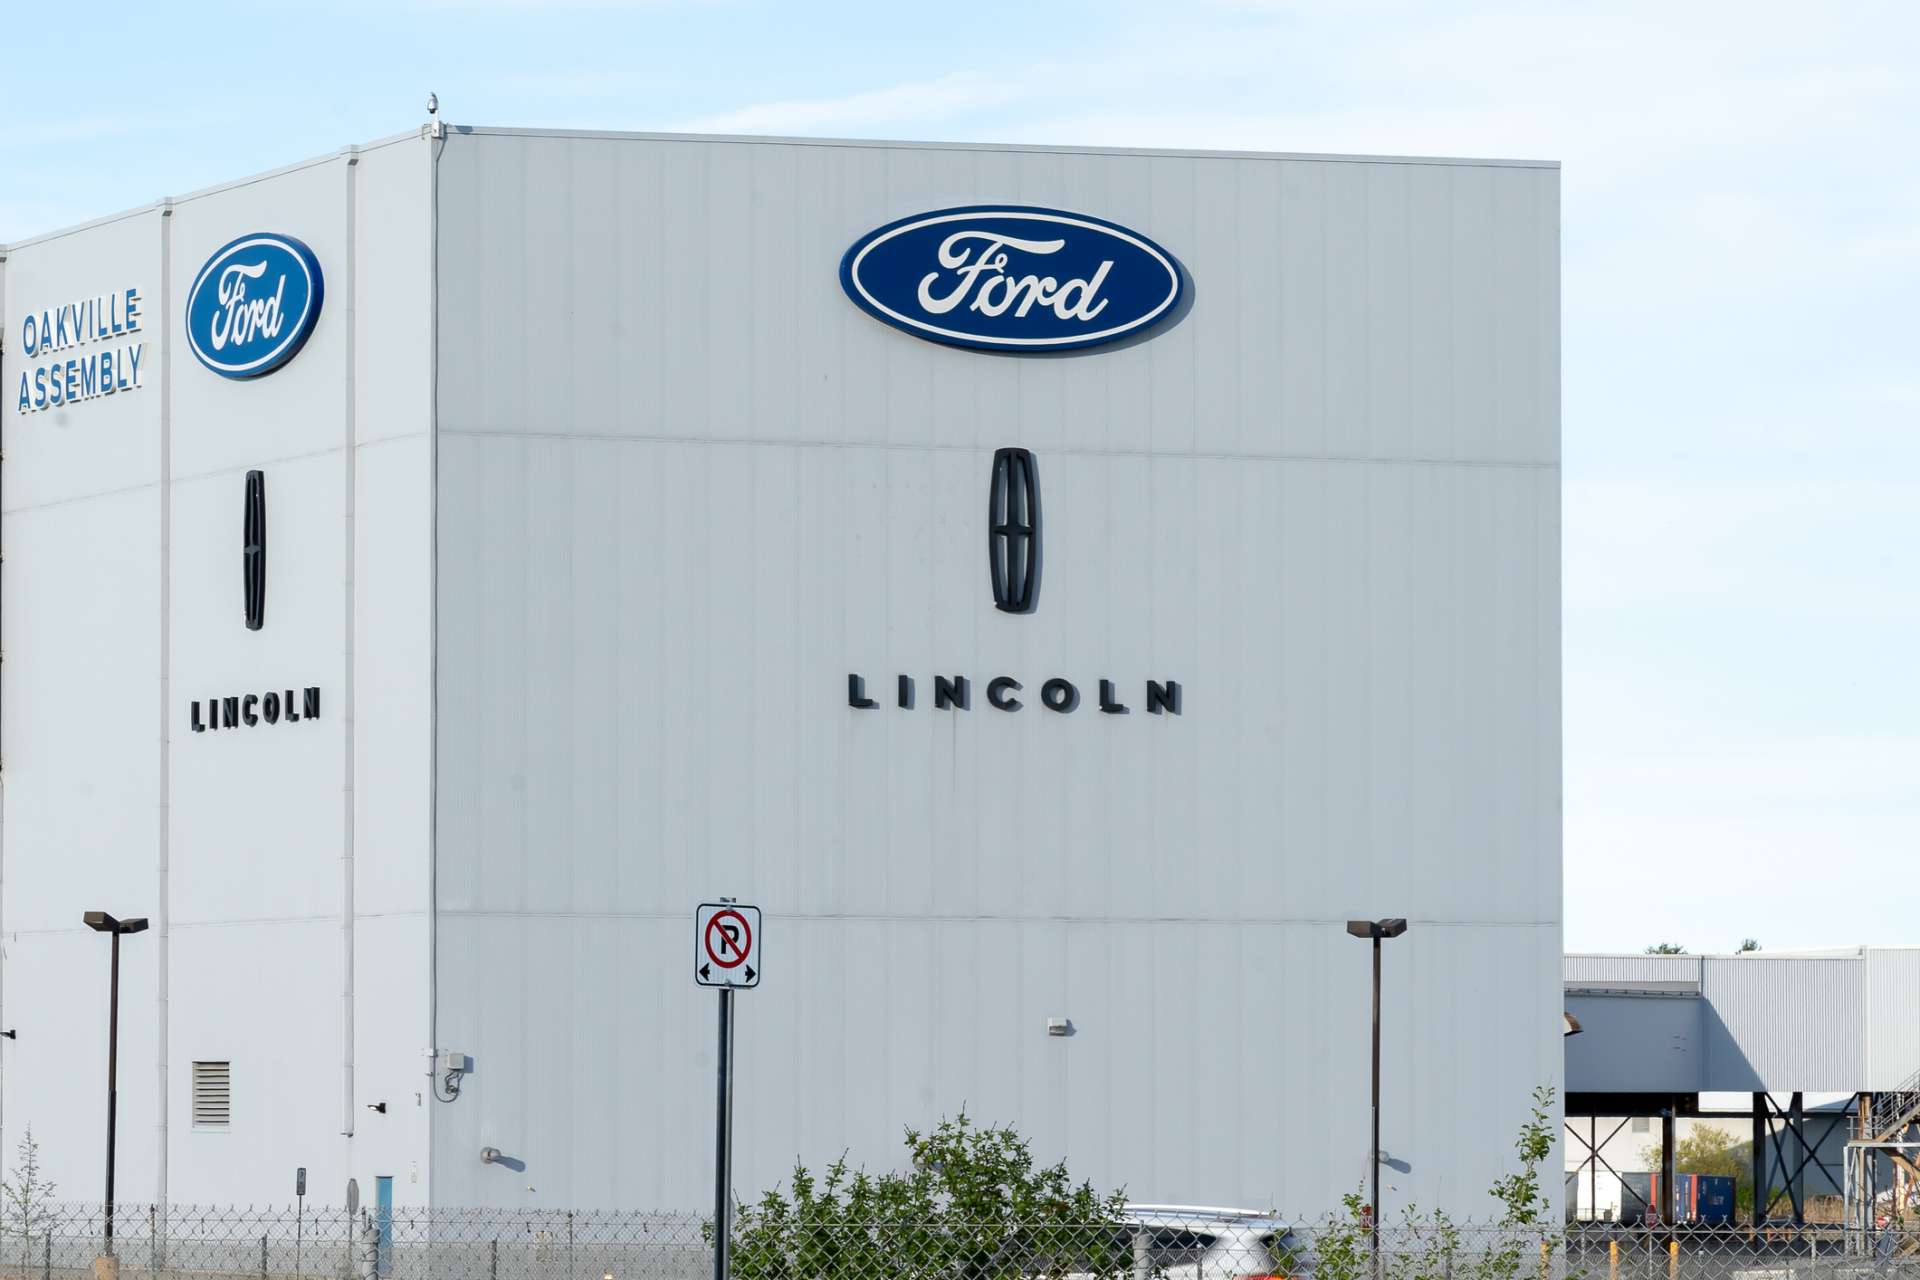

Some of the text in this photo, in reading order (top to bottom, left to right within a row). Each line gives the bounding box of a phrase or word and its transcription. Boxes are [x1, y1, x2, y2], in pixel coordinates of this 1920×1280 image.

[211, 260, 286, 350] Ford
[917, 230, 1114, 321] Ford
[22, 288, 139, 357] OAKVILLE
[18, 343, 142, 413] ASSEMBLY
[191, 687, 320, 732] LINCOLN
[848, 673, 1178, 713] LINCOLN
[720, 924, 740, 955] P
